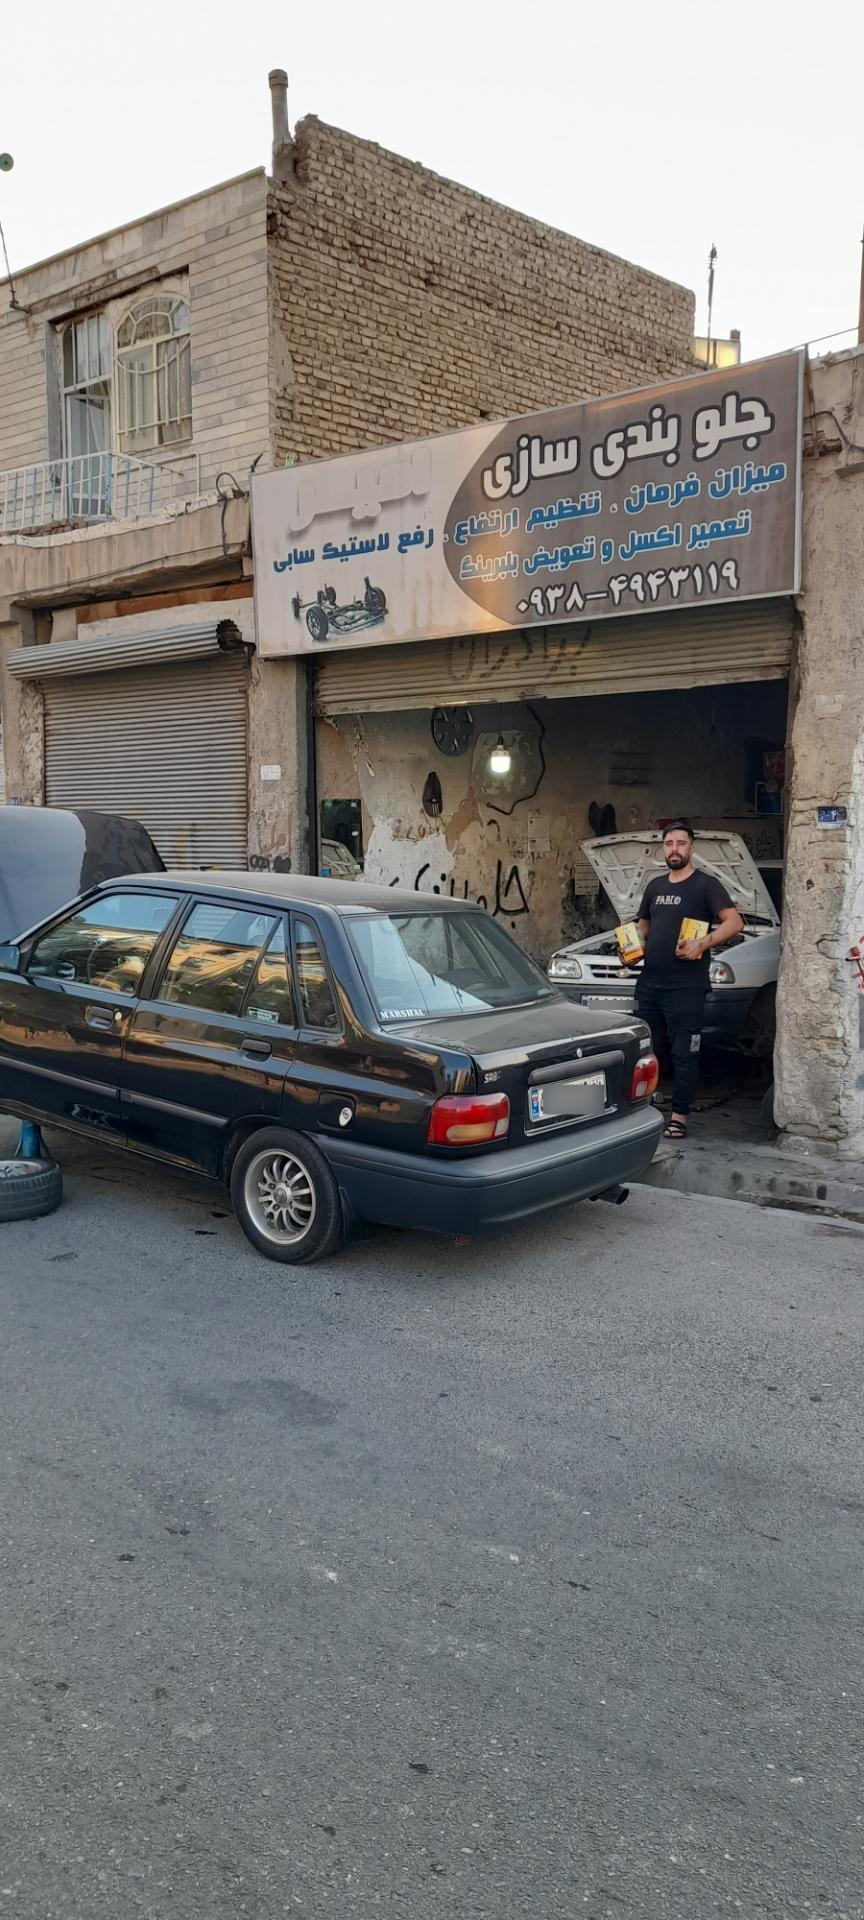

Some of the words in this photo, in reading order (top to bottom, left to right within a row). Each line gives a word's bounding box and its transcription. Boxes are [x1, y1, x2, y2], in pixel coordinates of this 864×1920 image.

[590, 404, 682, 480] بندی
[692, 391, 775, 462] جلو
[480, 433, 580, 500] سازی
[709, 461, 786, 499] میزان
[526, 491, 601, 532] تنظیم
[624, 473, 701, 514] فرمان
[397, 525, 434, 554] رفع
[454, 508, 519, 546] ارتفاع
[619, 523, 683, 562] اکسل
[686, 509, 752, 551] تعمیر
[273, 548, 315, 573] سابی
[322, 532, 390, 563] لاستیک
[459, 551, 519, 582] بلبرینگ
[522, 536, 596, 574] تعویض
[600, 539, 614, 564] و
[380, 1008, 425, 1021] MARSHAL
